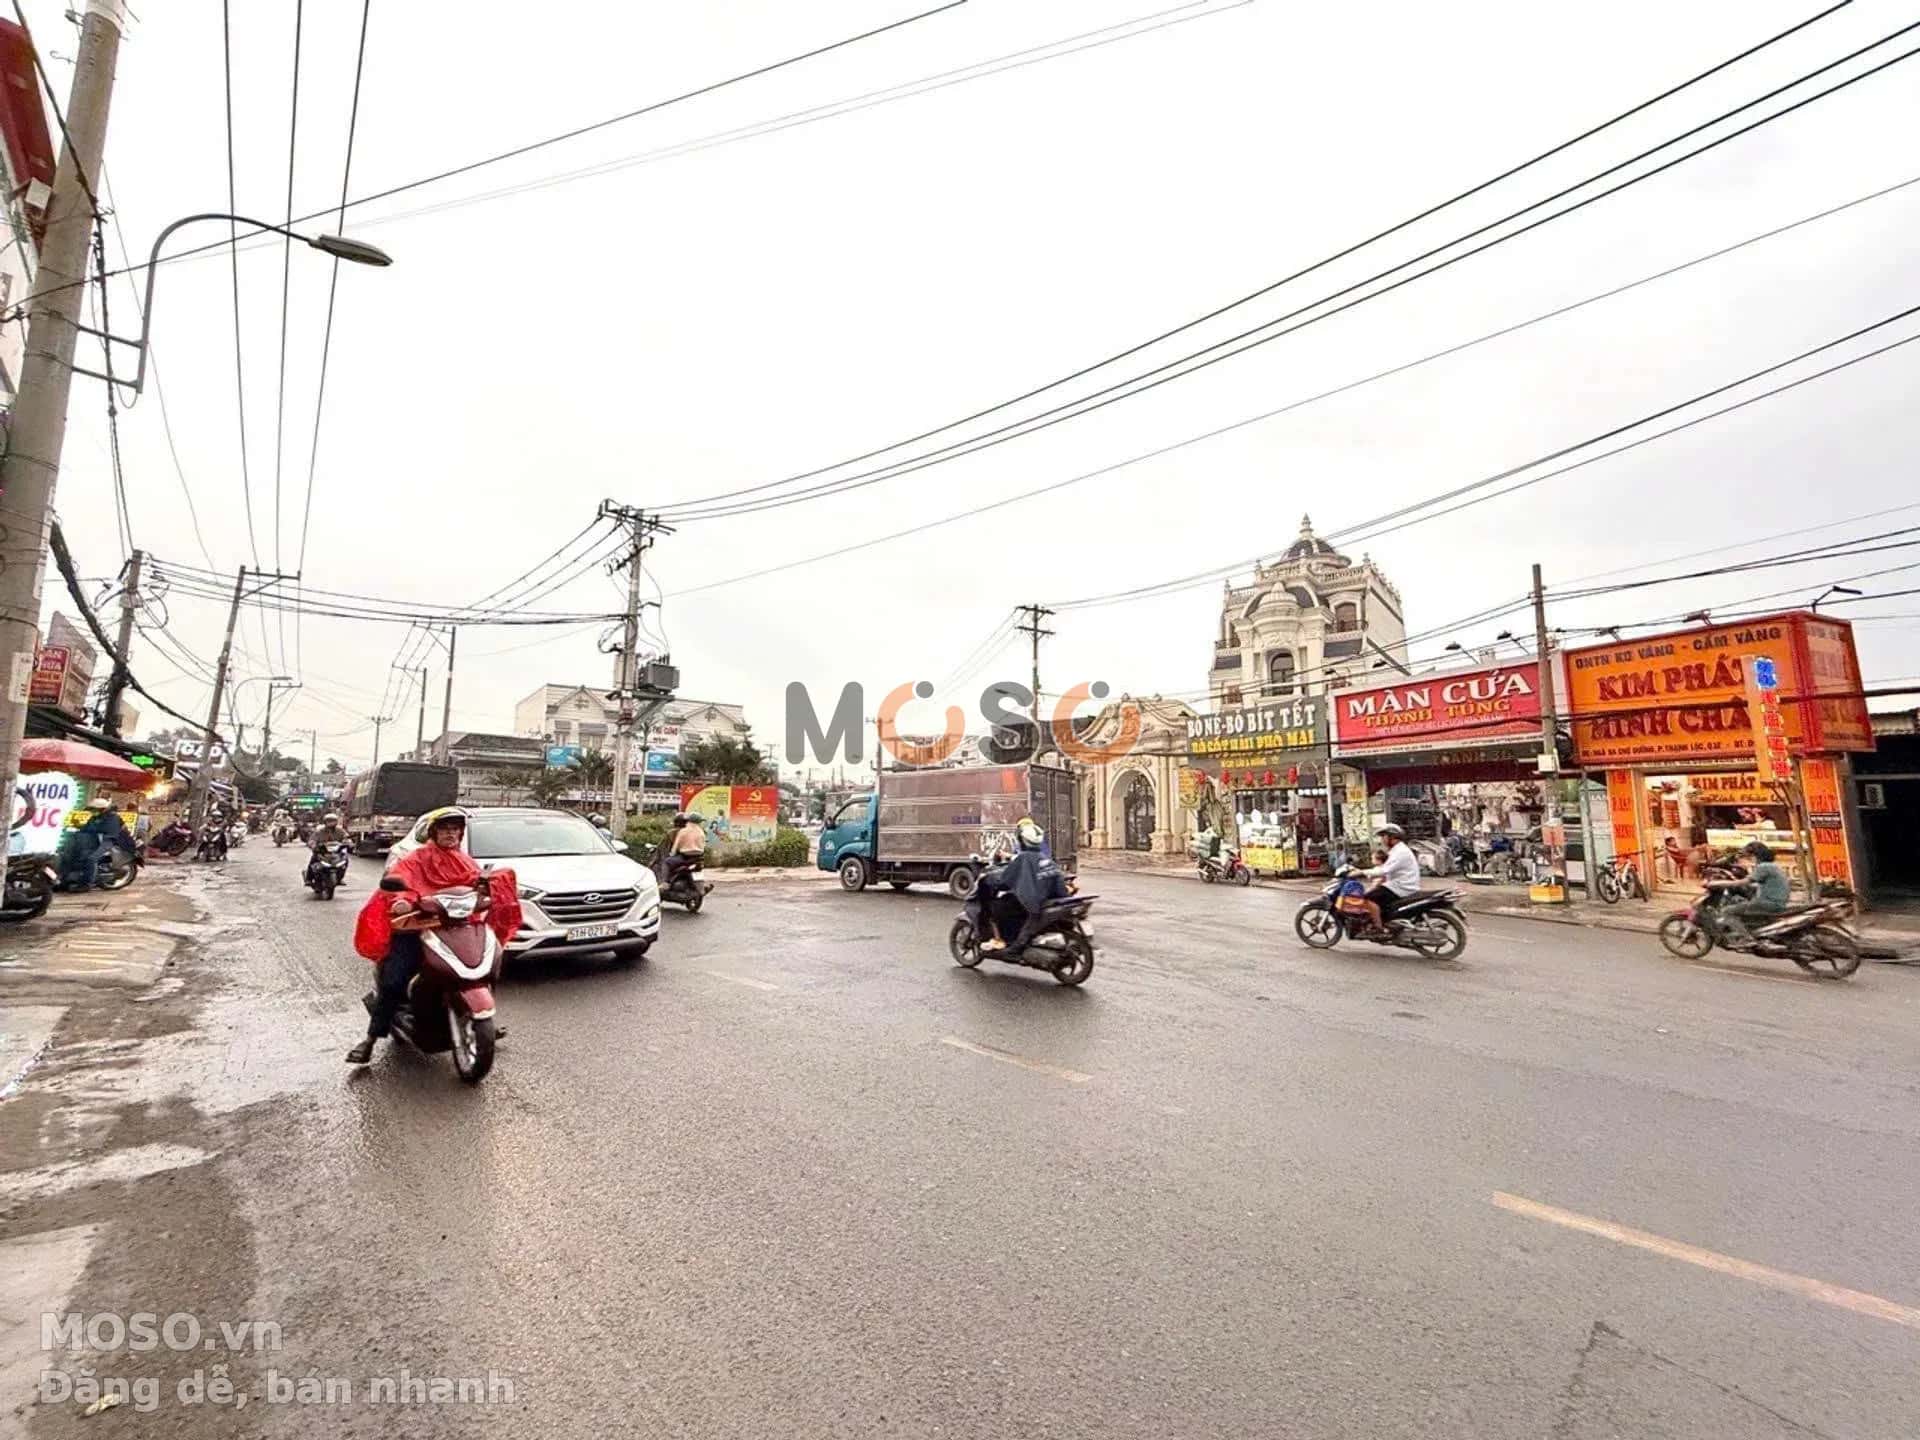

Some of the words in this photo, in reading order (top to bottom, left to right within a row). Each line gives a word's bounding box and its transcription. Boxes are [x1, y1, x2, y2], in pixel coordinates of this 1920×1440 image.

[1597, 670, 1658, 701] KIM
[1347, 688, 1432, 719] MÀN
[1679, 696, 1752, 734] CHÂ
[26, 783, 69, 799] KHOA
